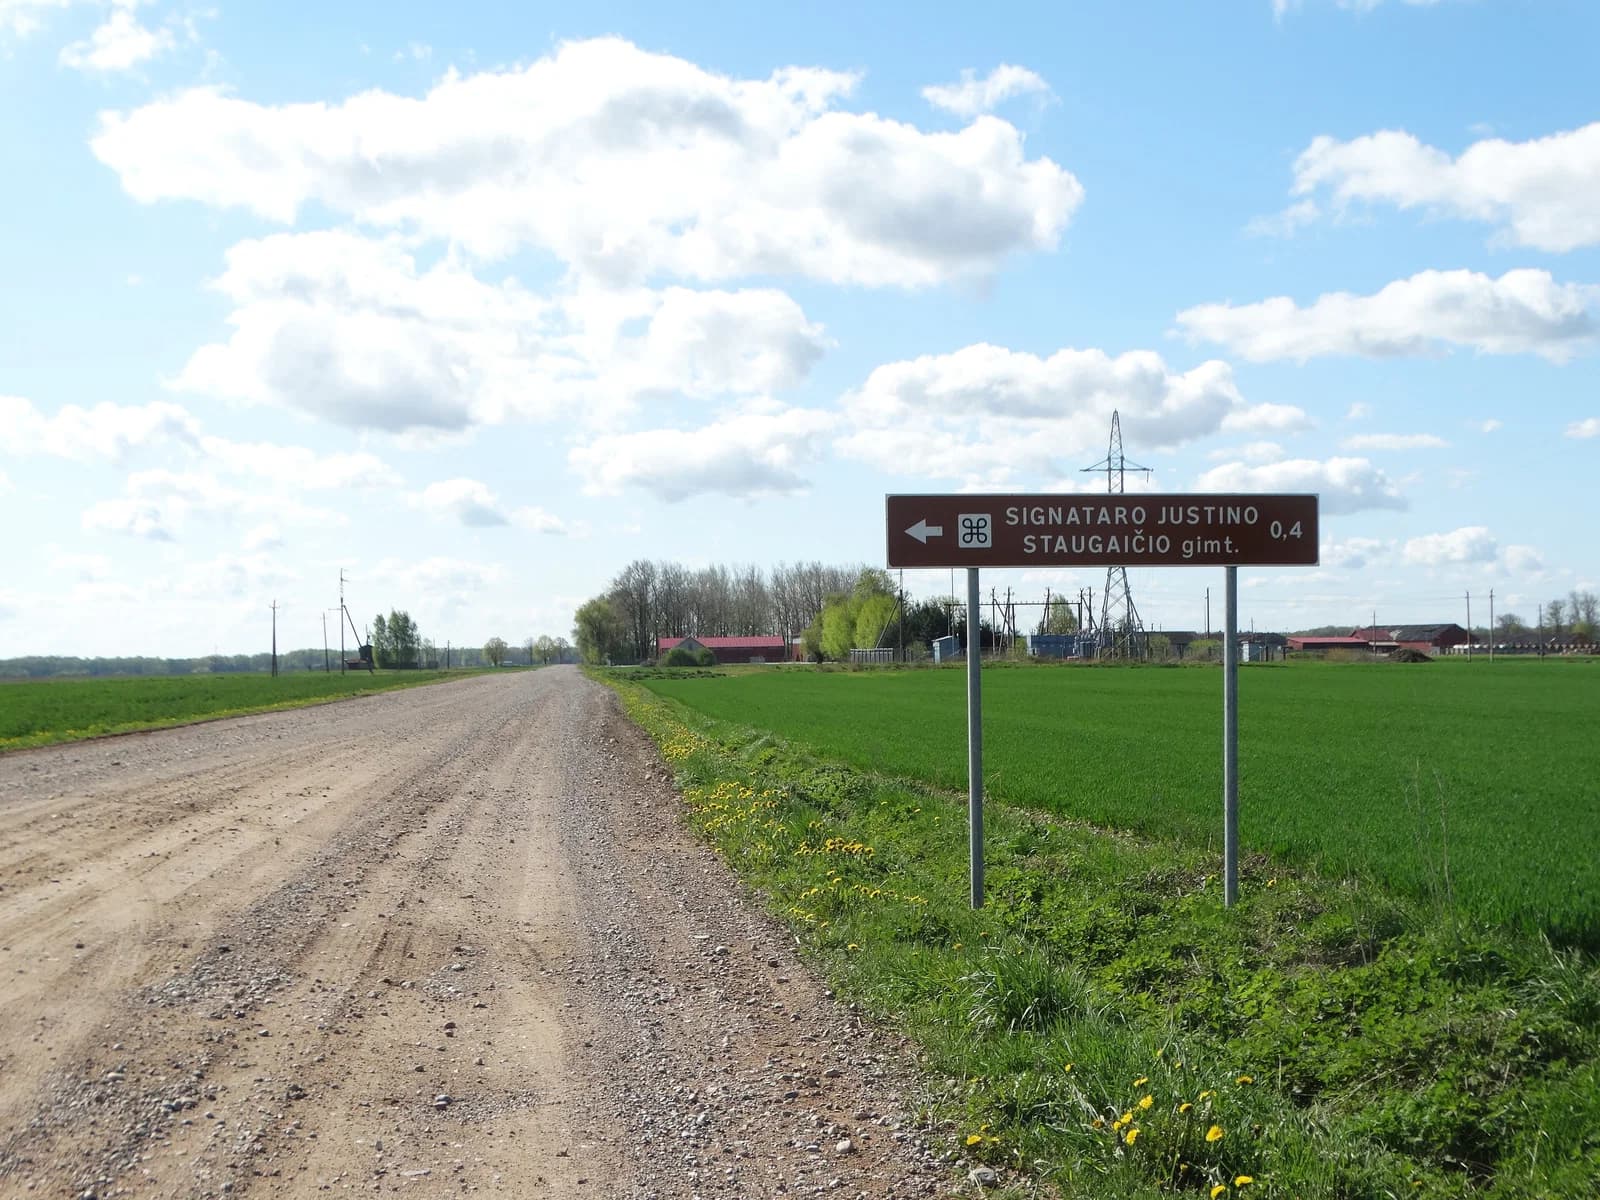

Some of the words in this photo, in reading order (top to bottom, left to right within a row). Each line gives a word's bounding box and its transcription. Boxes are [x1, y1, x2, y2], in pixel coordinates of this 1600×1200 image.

[1005, 507, 1147, 525] SIGNATARO
[1158, 507, 1259, 525] JUSTINO
[1270, 521, 1303, 540] 0,4
[1023, 529, 1171, 553] STAUGAIČIO
[1181, 536, 1240, 559] gimt.
